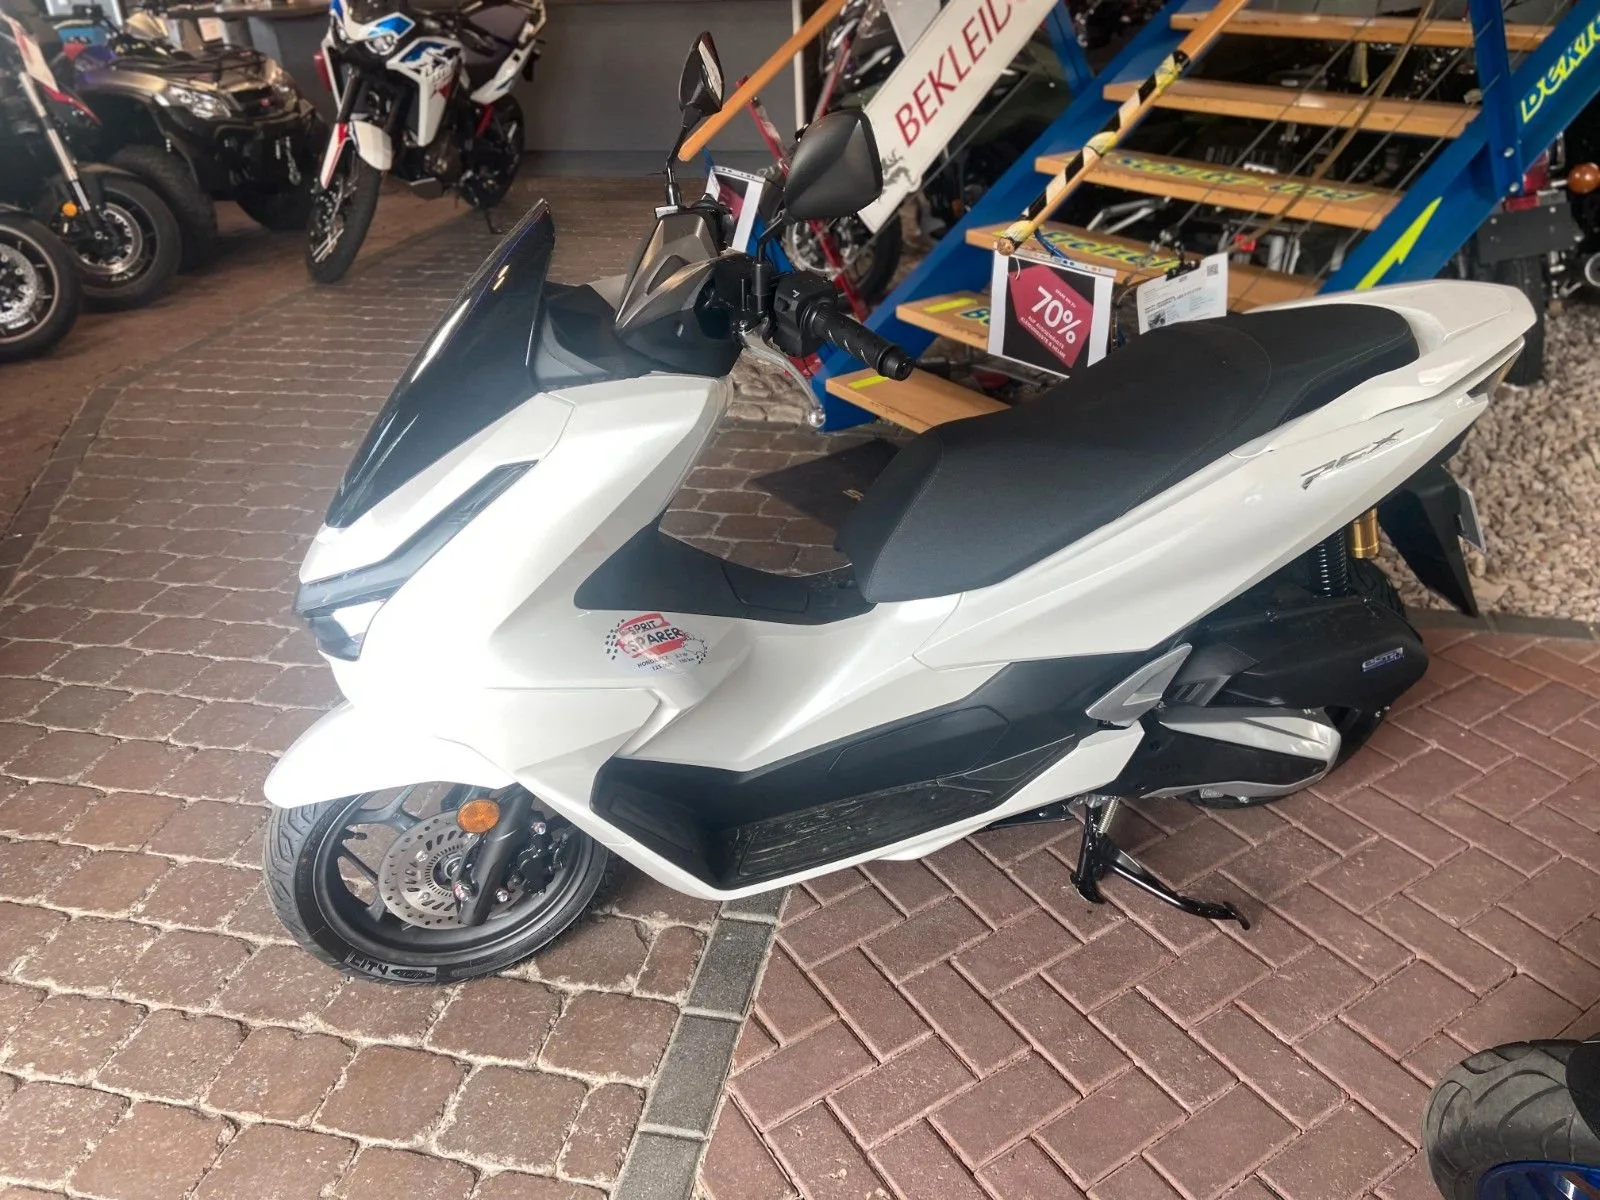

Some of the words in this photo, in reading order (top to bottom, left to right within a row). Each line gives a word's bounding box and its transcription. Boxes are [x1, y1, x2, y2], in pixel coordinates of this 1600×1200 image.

[895, 0, 1028, 148] BEKLEID
[1031, 285, 1082, 344] 70%
[627, 627, 683, 653] SPARER
[628, 619, 657, 635] SPRIT
[348, 956, 389, 975] CITY
